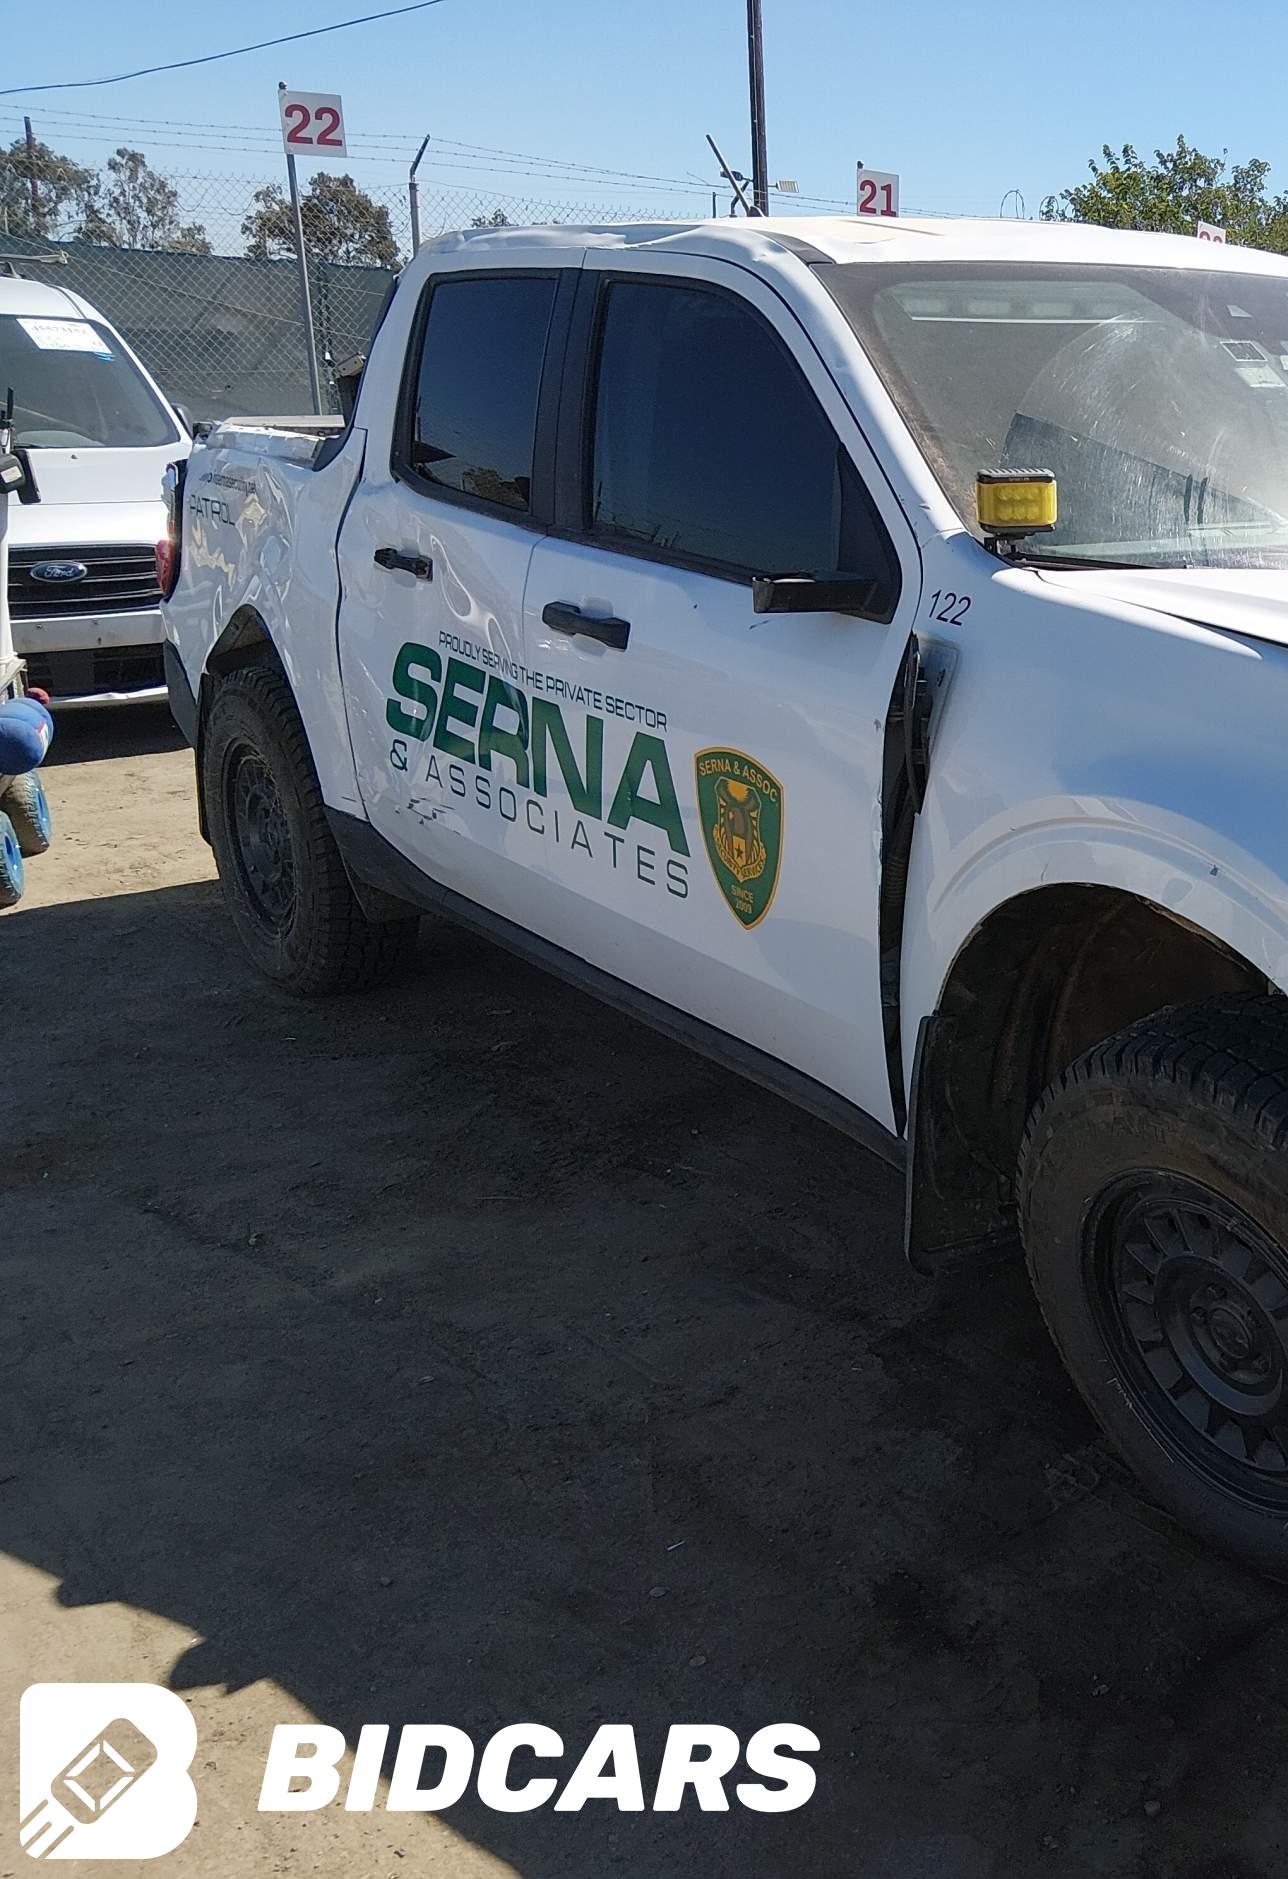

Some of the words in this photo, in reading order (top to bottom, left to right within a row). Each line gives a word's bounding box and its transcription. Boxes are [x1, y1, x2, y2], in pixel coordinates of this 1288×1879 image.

[285, 104, 343, 147] 22
[860, 179, 897, 218] 21
[190, 494, 235, 526] PATROL
[929, 589, 971, 626] 122
[439, 630, 480, 660] PROUDLY
[482, 649, 518, 680] SERVING
[519, 665, 543, 691] THE
[546, 675, 602, 711] PRIVATE
[605, 695, 667, 732] SECTOR
[385, 641, 691, 858] SERNA
[699, 758, 731, 776] SERNA
[733, 760, 740, 775] &
[742, 764, 778, 802] ASSOC
[390, 738, 408, 772] &
[425, 754, 689, 899] ASSOCIATES
[731, 884, 754, 903] SINCE
